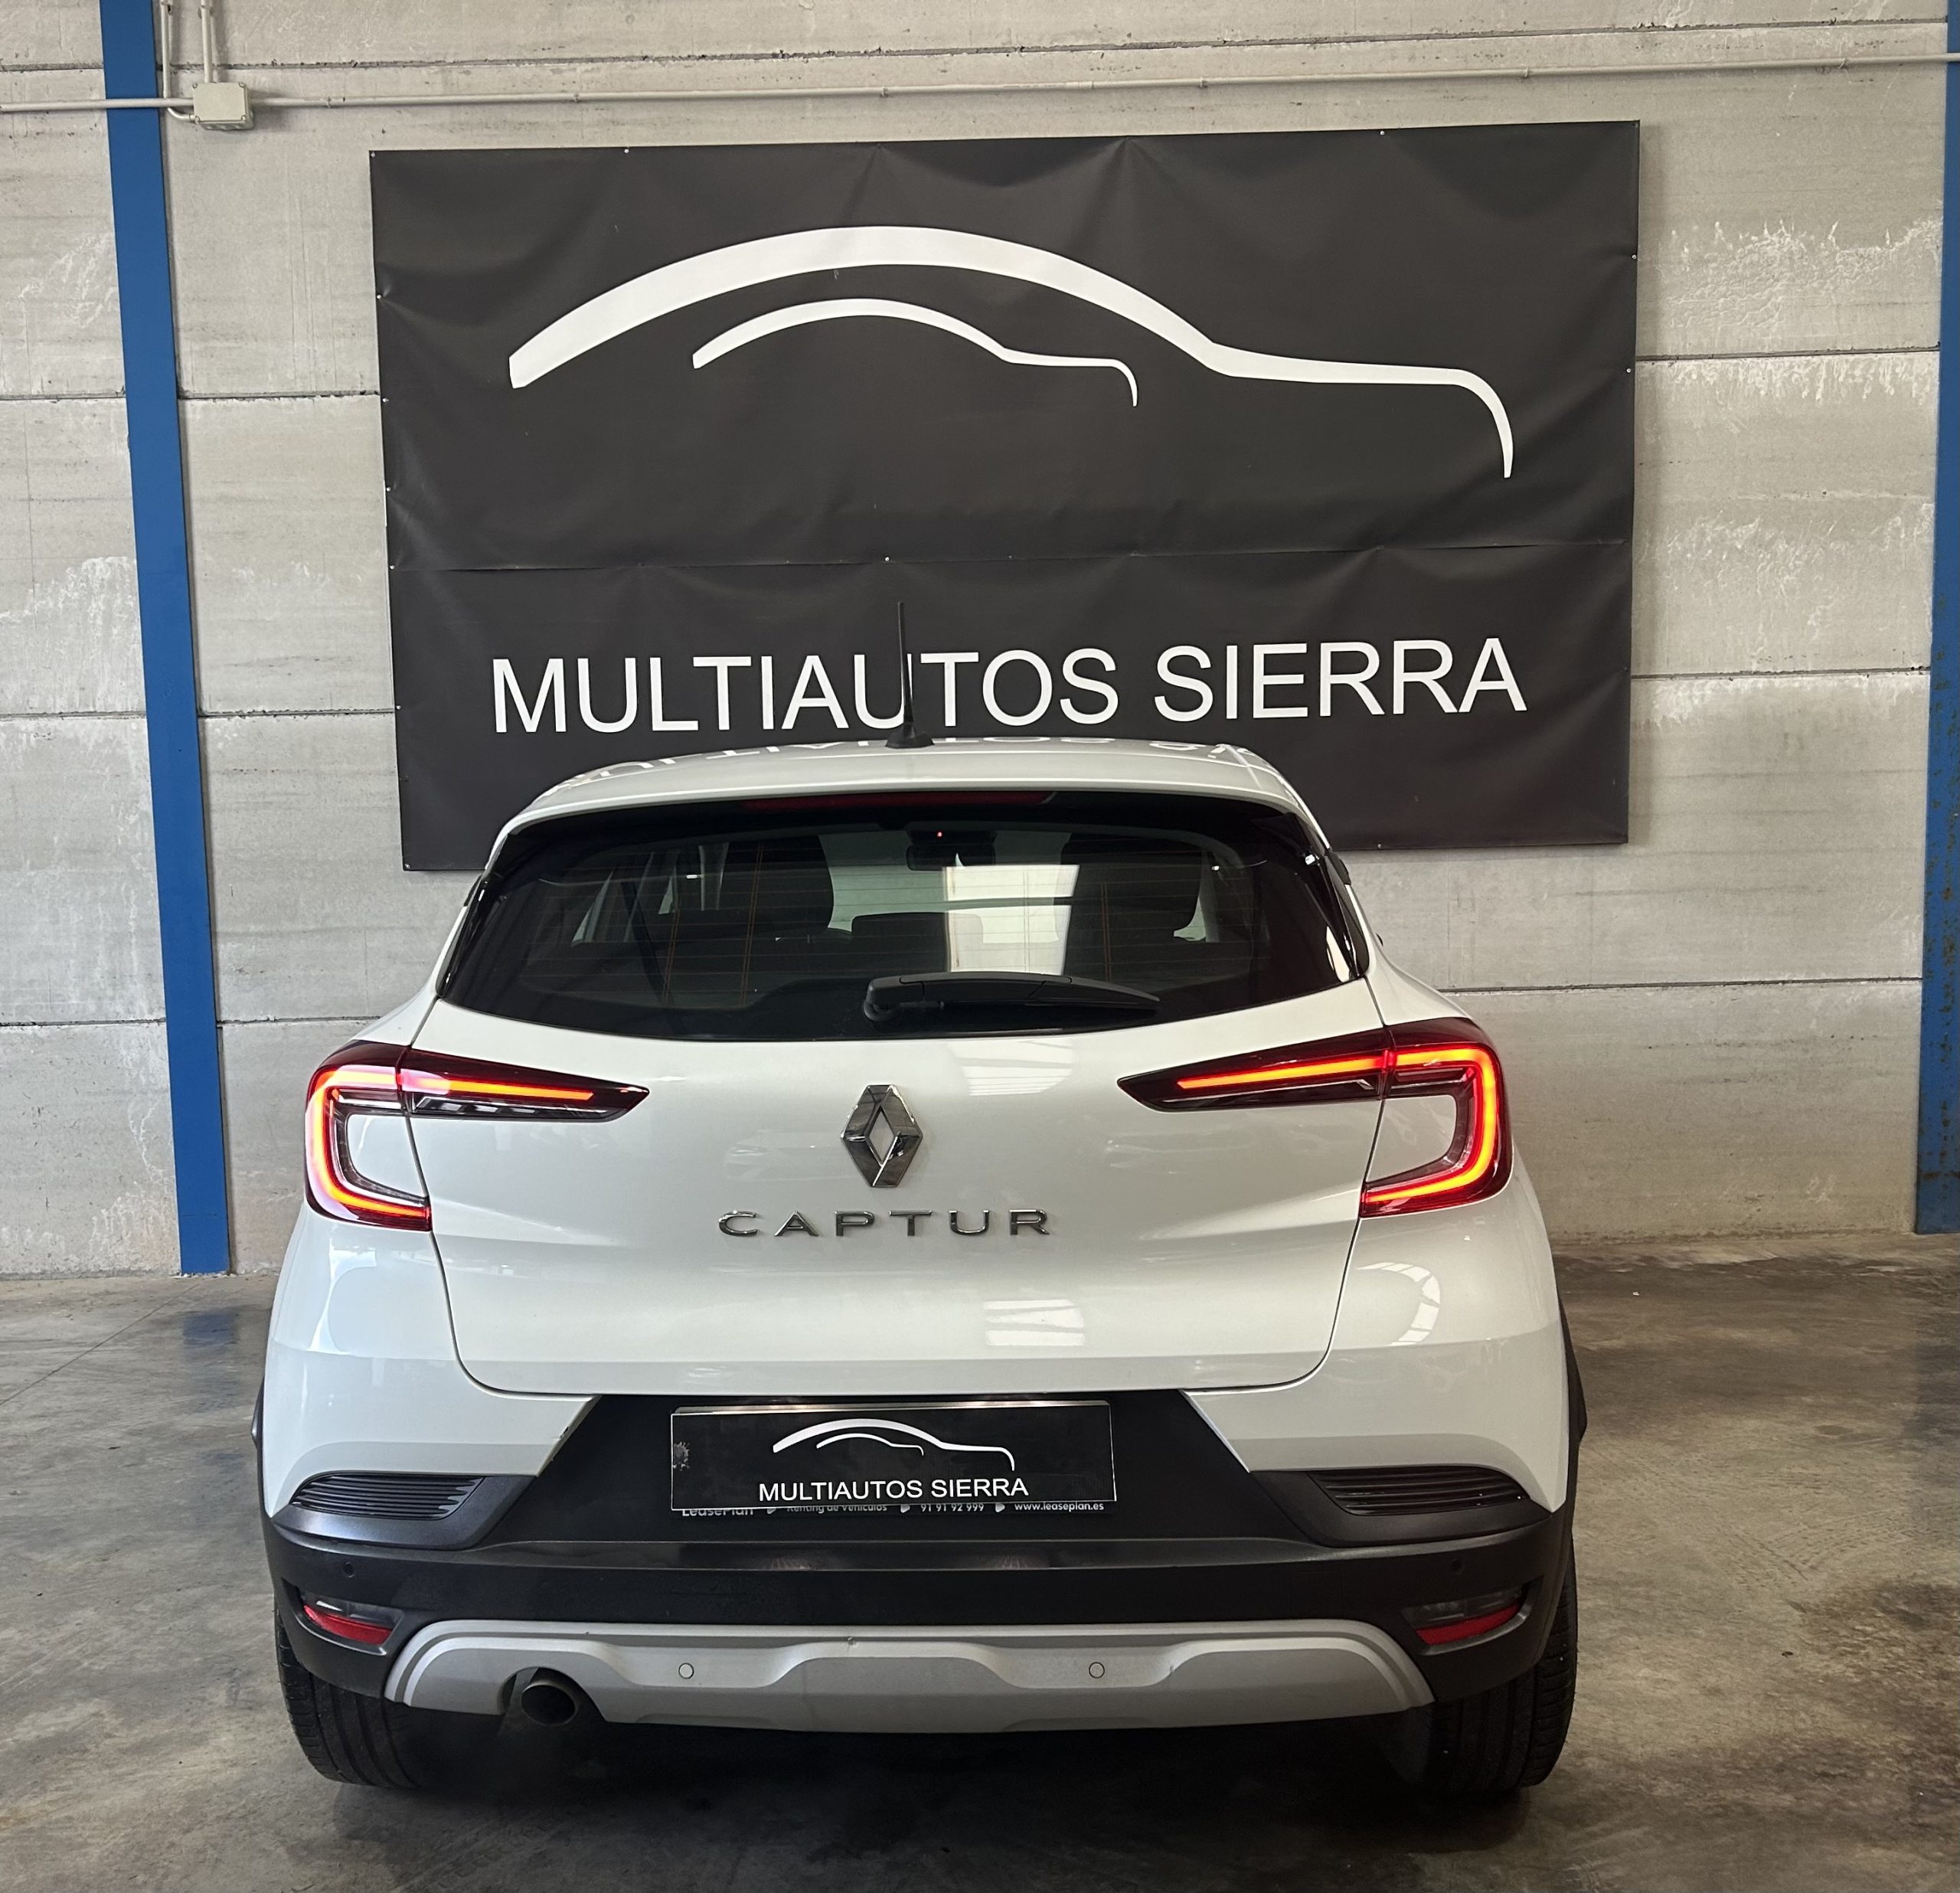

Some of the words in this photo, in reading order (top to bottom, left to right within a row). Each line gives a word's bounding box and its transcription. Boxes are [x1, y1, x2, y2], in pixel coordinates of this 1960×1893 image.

[492, 649, 1119, 733] MULTIAUTOS
[1154, 637, 1527, 721] SIERRA
[718, 1209, 1050, 1237] CAPTUR
[759, 1479, 923, 1502] MULTIAUTOS
[931, 1477, 1029, 1498] SIERRA
[921, 1503, 932, 1512] 91
[936, 1503, 946, 1512] 91
[951, 1503, 963, 1512] 92
[966, 1502, 985, 1512] 999
[1014, 1501, 1105, 1512] www.leaseplan.es
